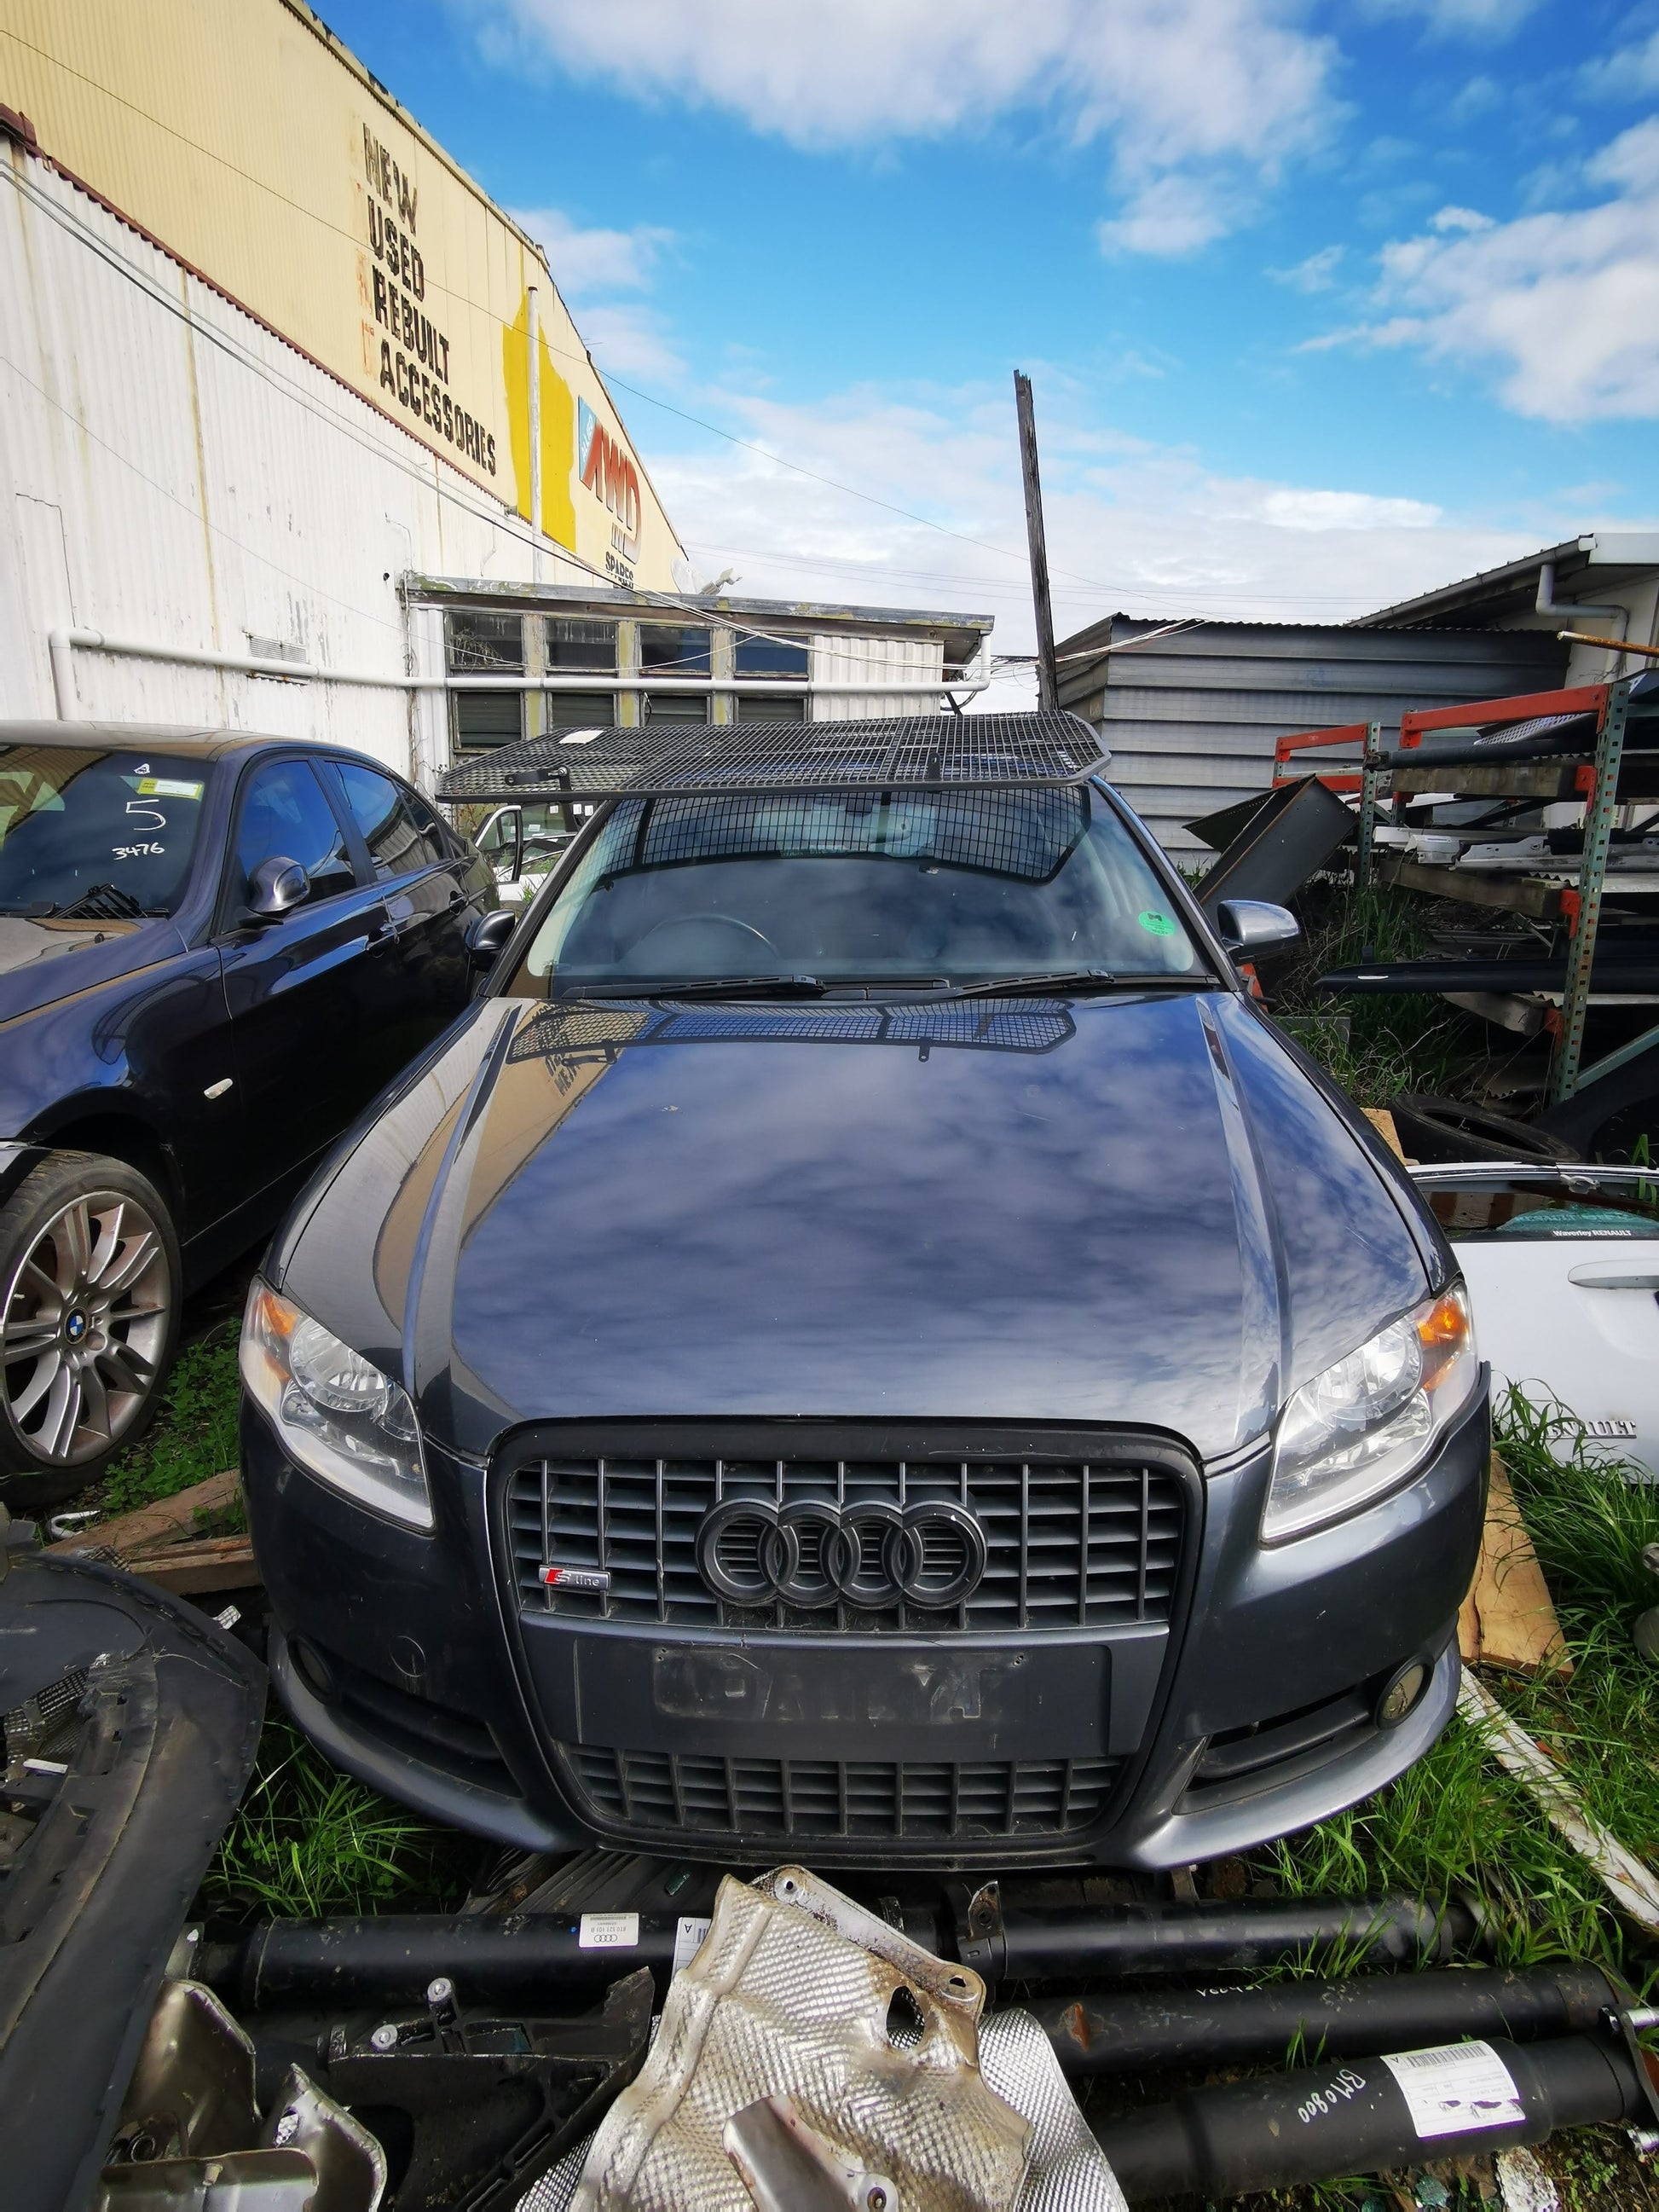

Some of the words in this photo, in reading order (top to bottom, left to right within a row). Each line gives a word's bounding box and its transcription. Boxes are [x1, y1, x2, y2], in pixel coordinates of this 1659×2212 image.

[362, 122, 418, 238] NEW
[367, 194, 425, 303] USED
[372, 263, 450, 385] REBUILT
[379, 338, 497, 478] ACCESSORIES
[605, 551, 634, 589] SPARES
[125, 799, 166, 831] 5
[112, 842, 165, 860] 3476
[575, 1575, 600, 1587] line
[684, 1924, 693, 1934] A
